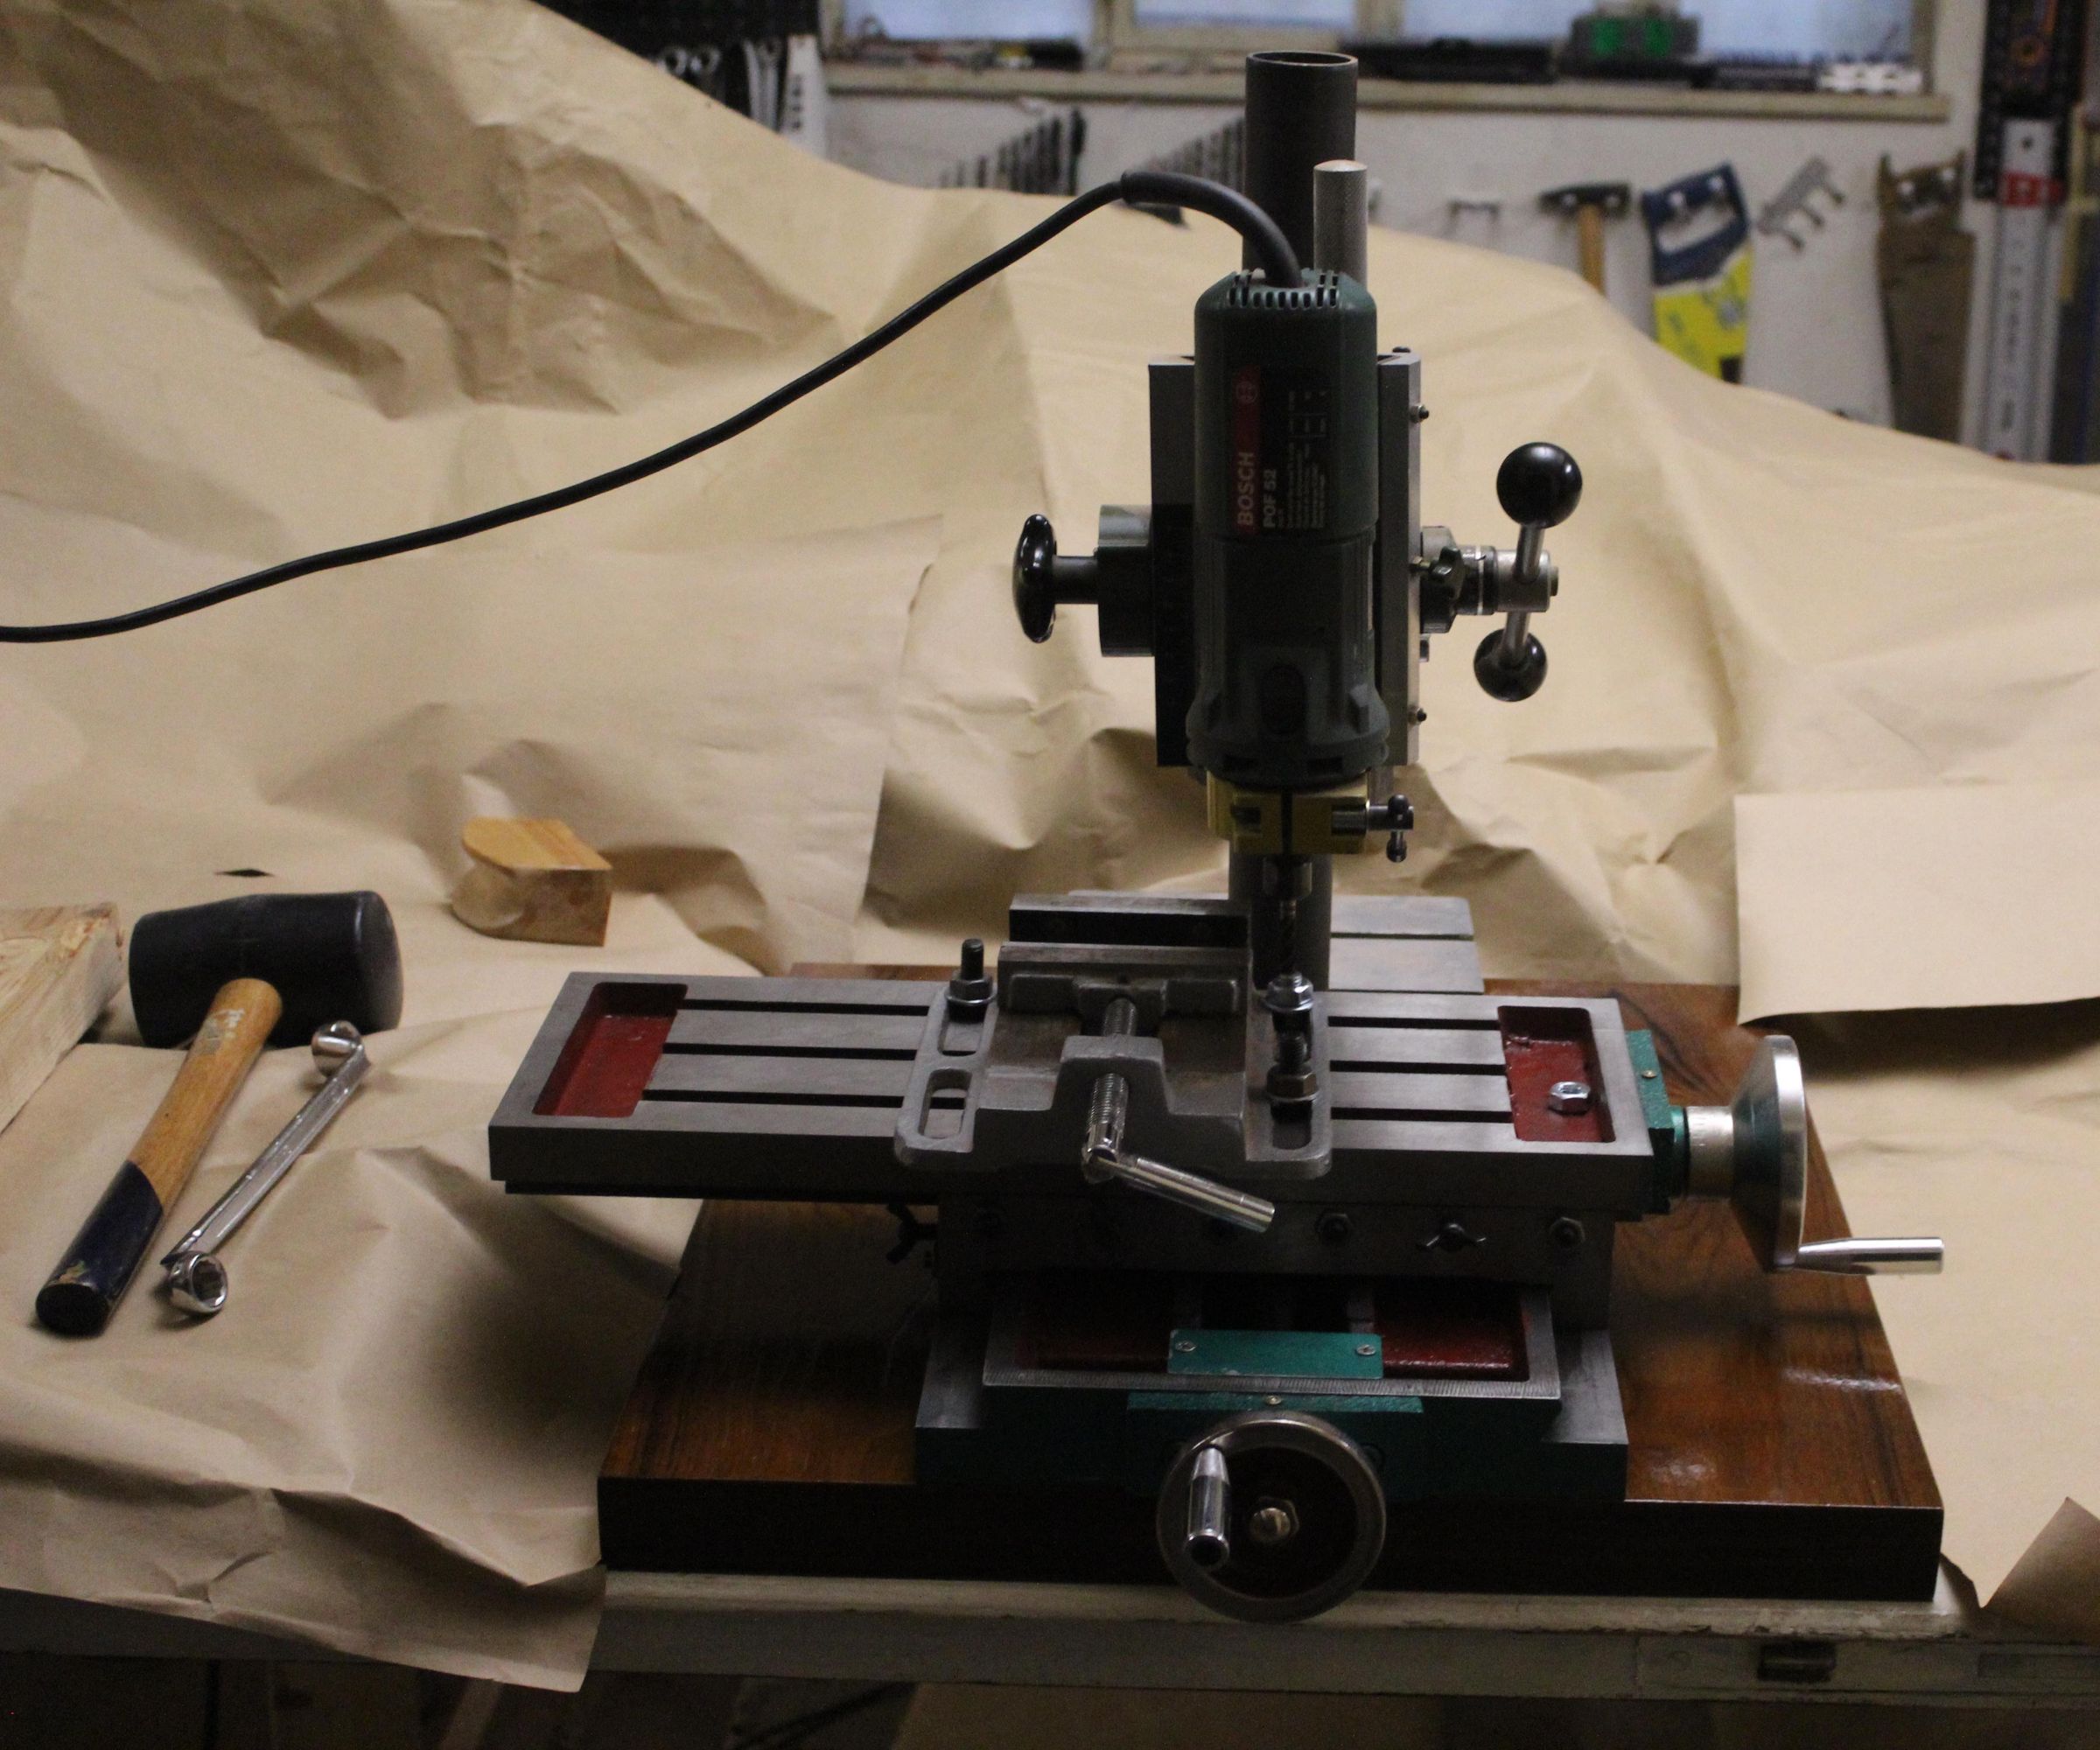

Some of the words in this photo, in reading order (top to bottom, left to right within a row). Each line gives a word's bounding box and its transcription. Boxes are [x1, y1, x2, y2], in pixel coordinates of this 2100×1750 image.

[1237, 452, 1255, 526] BOSCH
[1264, 469, 1278, 491] 52
[1264, 494, 1278, 528] POF
